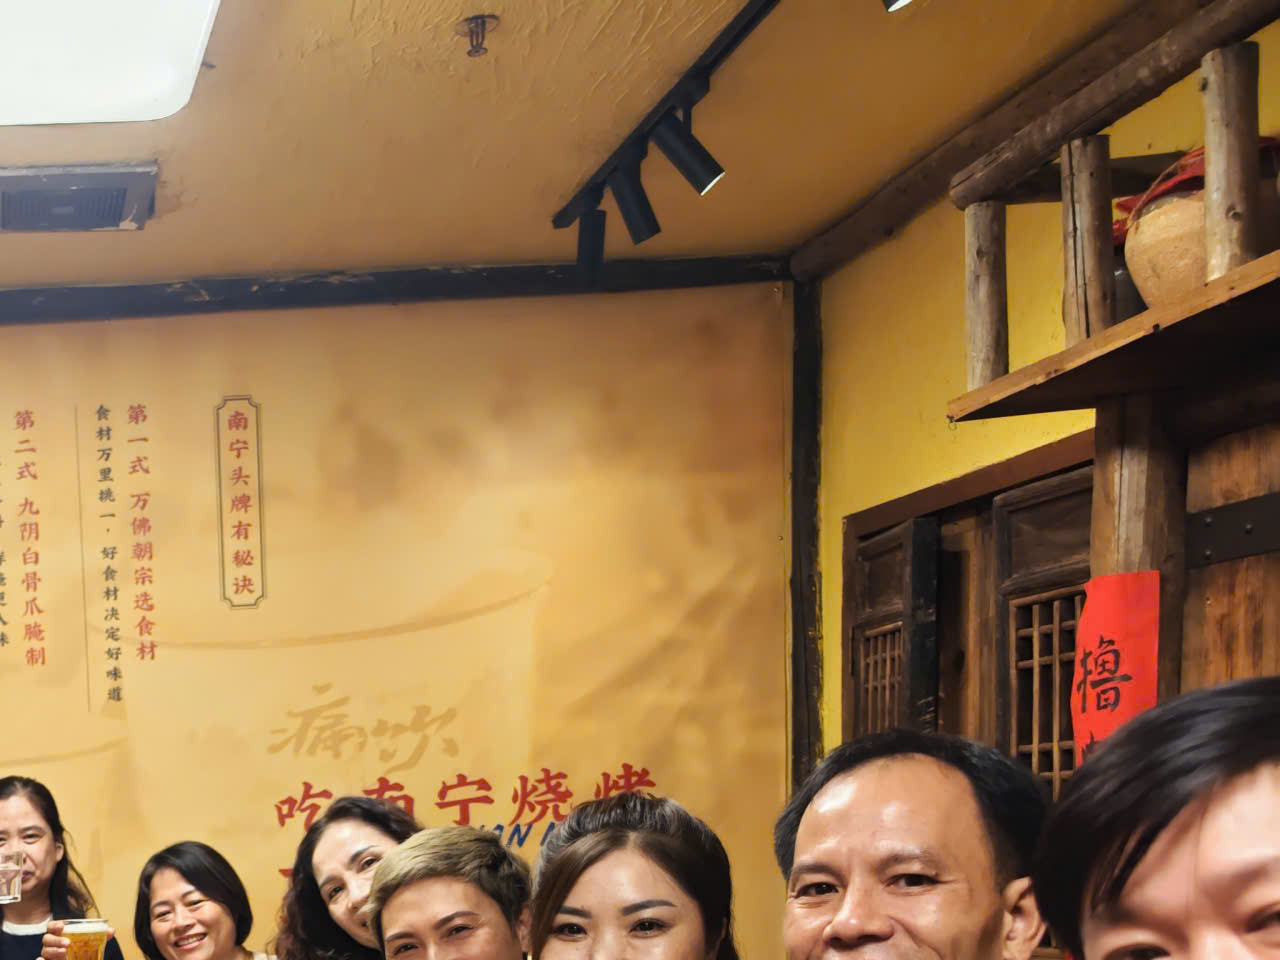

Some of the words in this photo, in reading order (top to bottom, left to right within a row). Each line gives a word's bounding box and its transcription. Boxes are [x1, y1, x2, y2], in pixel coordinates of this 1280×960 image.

[14, 409, 38, 481] 第二式
[126, 404, 151, 476] 第一式
[227, 410, 255, 595] 南宁头牌有秘诀
